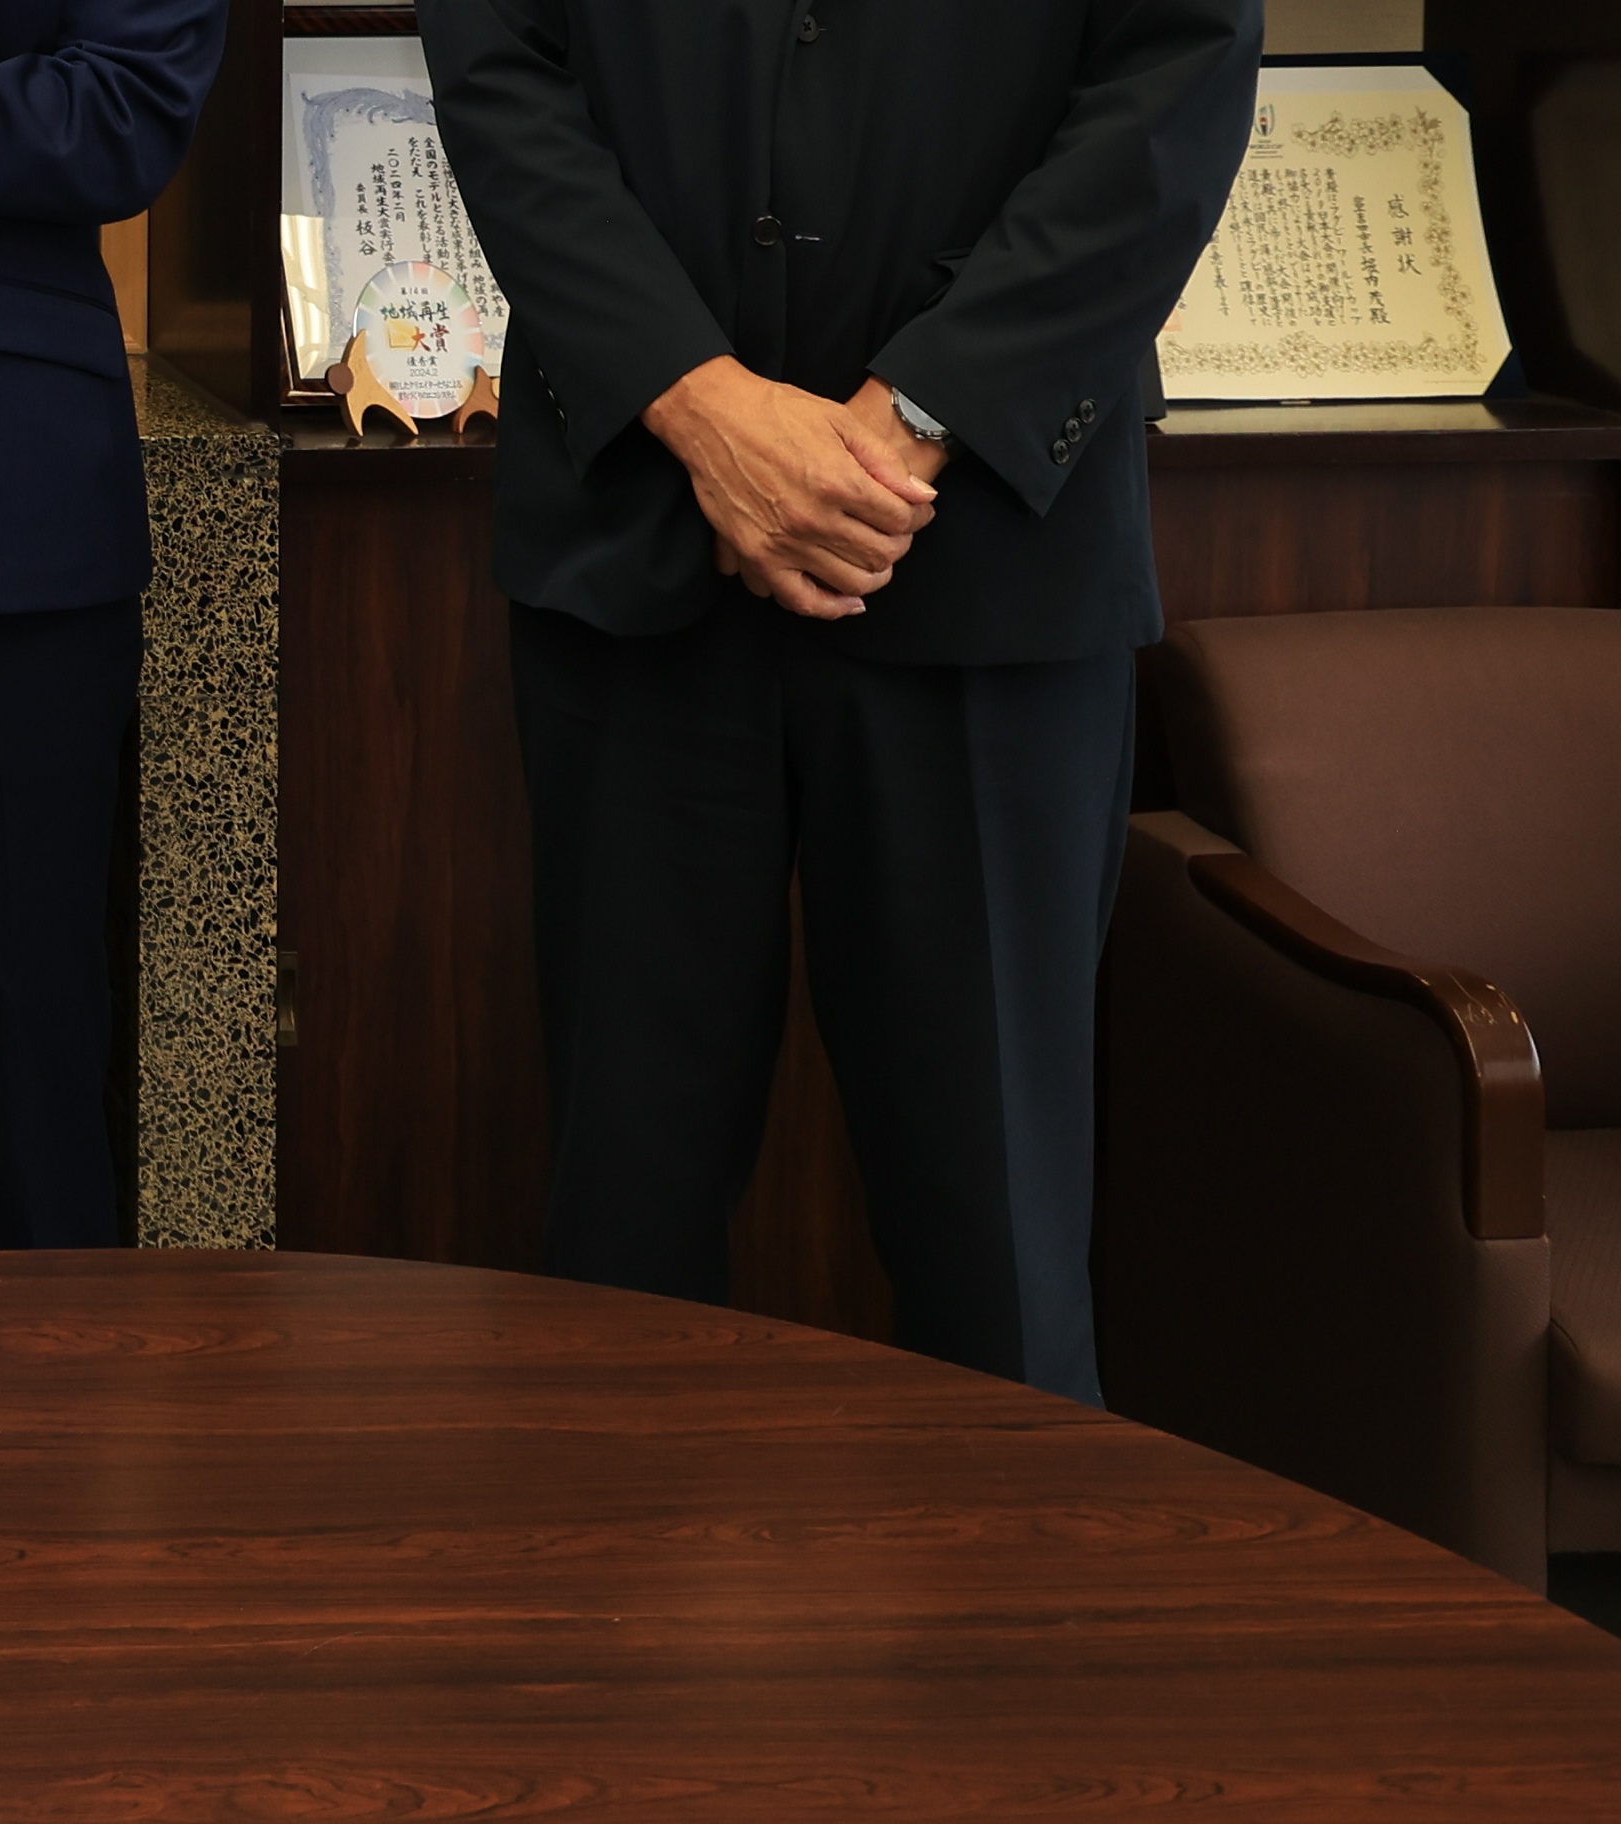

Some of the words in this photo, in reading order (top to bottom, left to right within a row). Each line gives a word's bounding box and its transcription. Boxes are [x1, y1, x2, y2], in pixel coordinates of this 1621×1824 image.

[1388, 194, 1421, 276] 感謝状
[380, 298, 450, 322] 地域再生
[412, 323, 450, 353] 大賞
